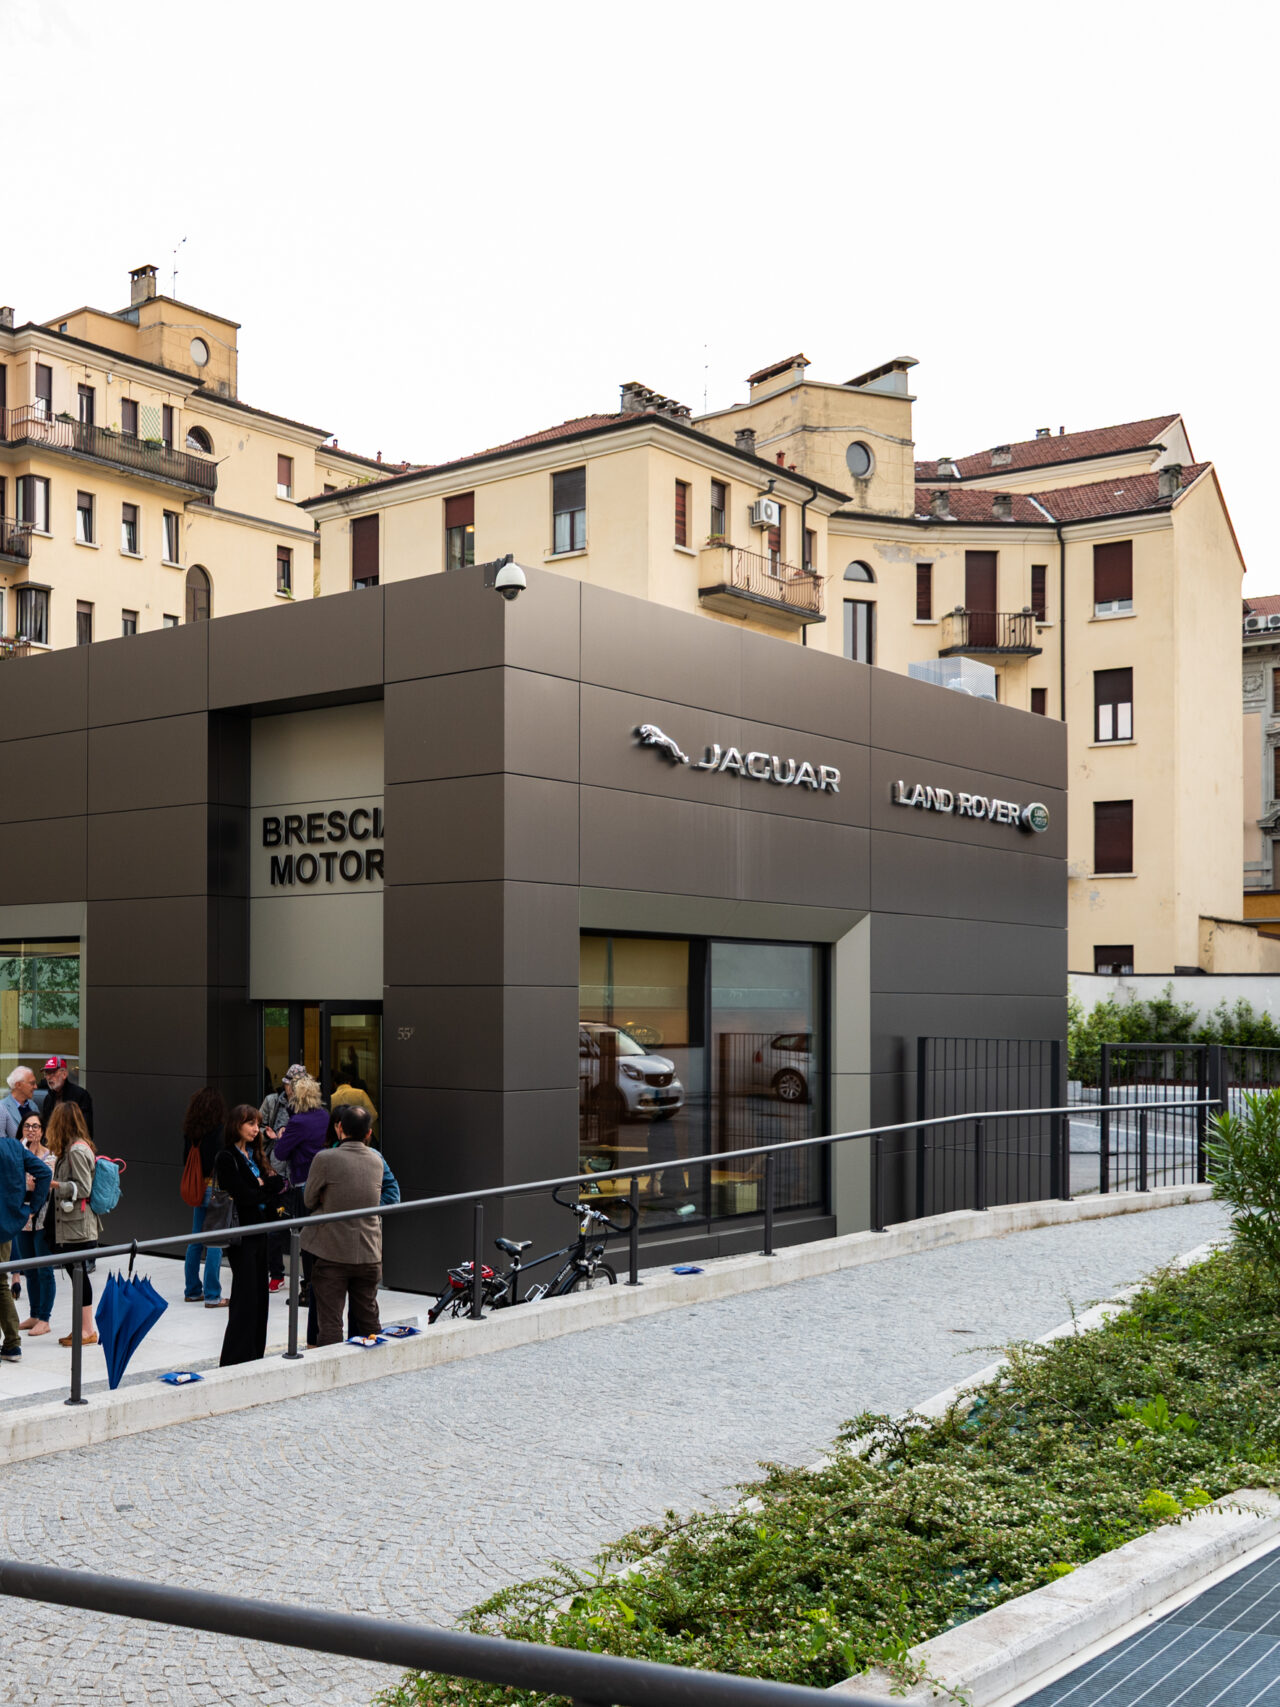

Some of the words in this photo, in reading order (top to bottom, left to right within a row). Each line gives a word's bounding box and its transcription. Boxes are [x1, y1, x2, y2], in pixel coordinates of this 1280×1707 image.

[697, 743, 841, 793] JAGUAR
[897, 780, 955, 812] LAND
[958, 792, 1020, 825] ROVER
[262, 807, 384, 847] BRESCI
